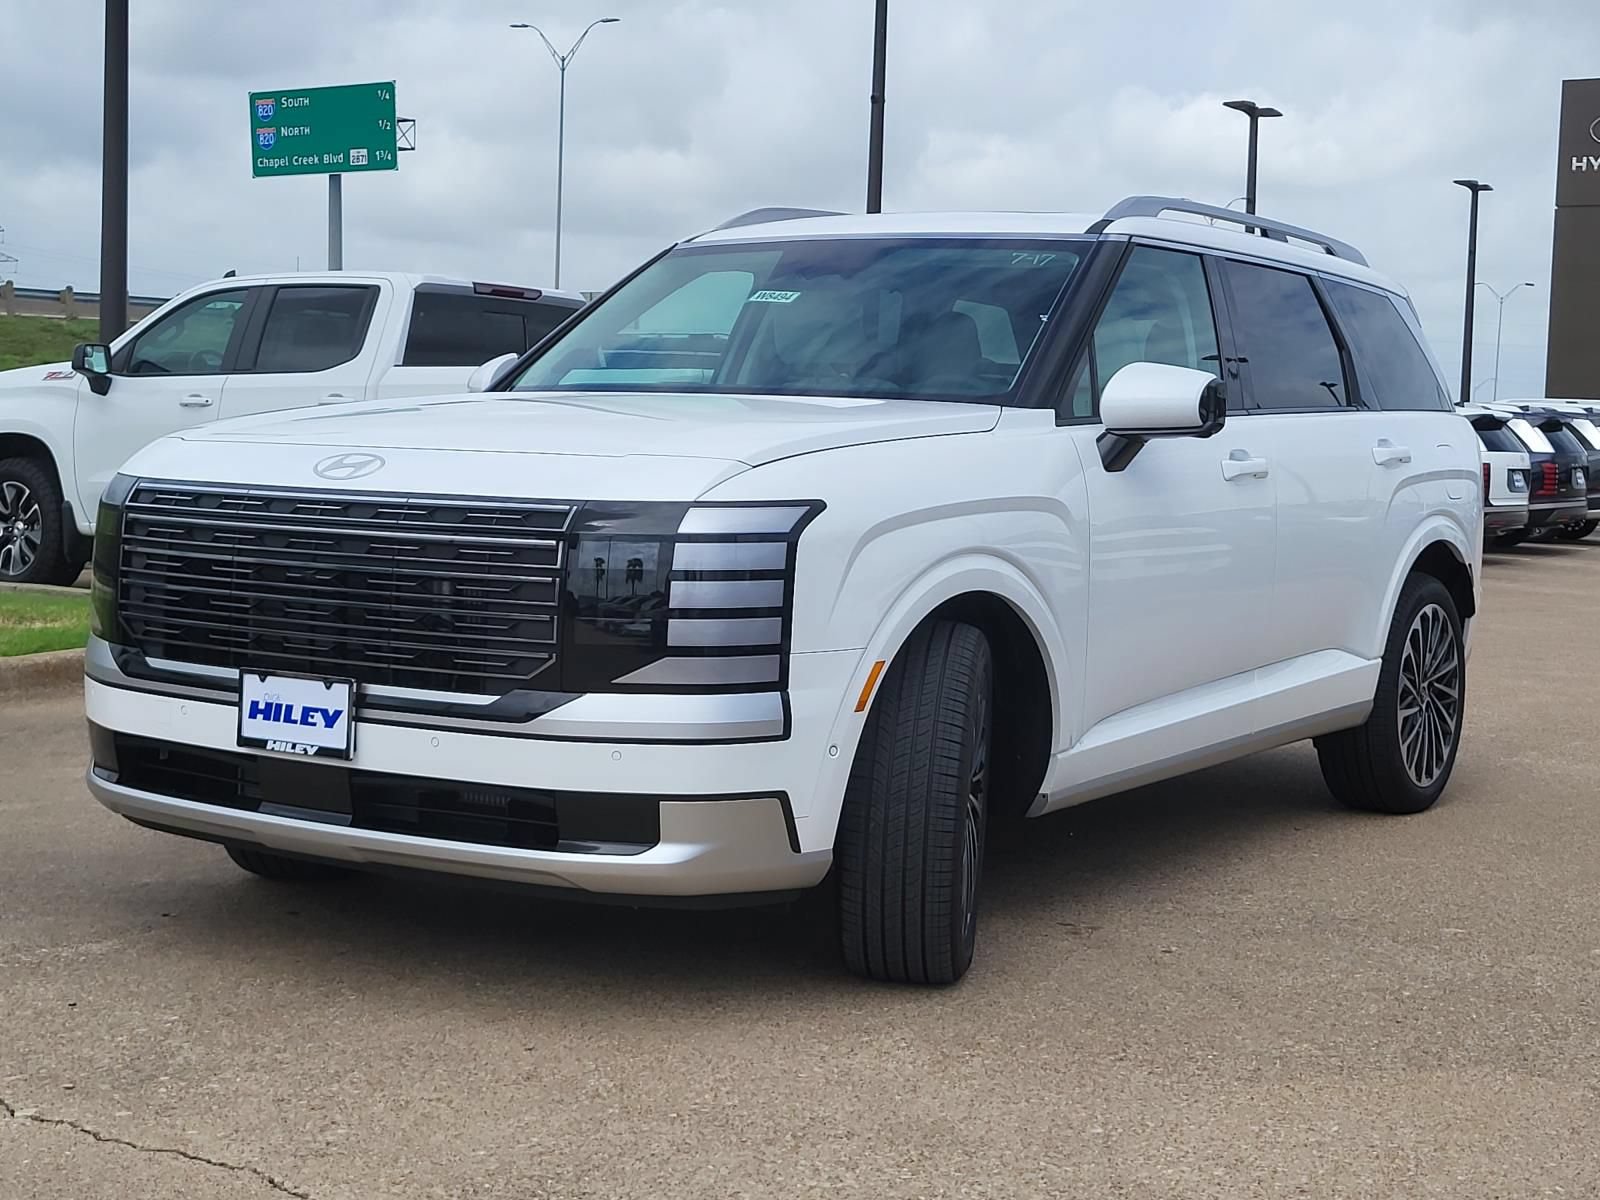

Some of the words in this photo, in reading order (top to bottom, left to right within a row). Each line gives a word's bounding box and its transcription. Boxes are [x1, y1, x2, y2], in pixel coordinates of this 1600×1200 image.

[258, 104, 273, 116] 820
[281, 97, 310, 107] SOUTH
[259, 133, 274, 145] 820
[281, 127, 310, 137] NORTH
[257, 157, 289, 168] Chapel
[292, 155, 320, 166] Creek
[323, 153, 344, 164] Blvd
[1011, 252, 1057, 266] 7-17
[248, 700, 344, 729] HILEY
[266, 740, 319, 755] HILEY
